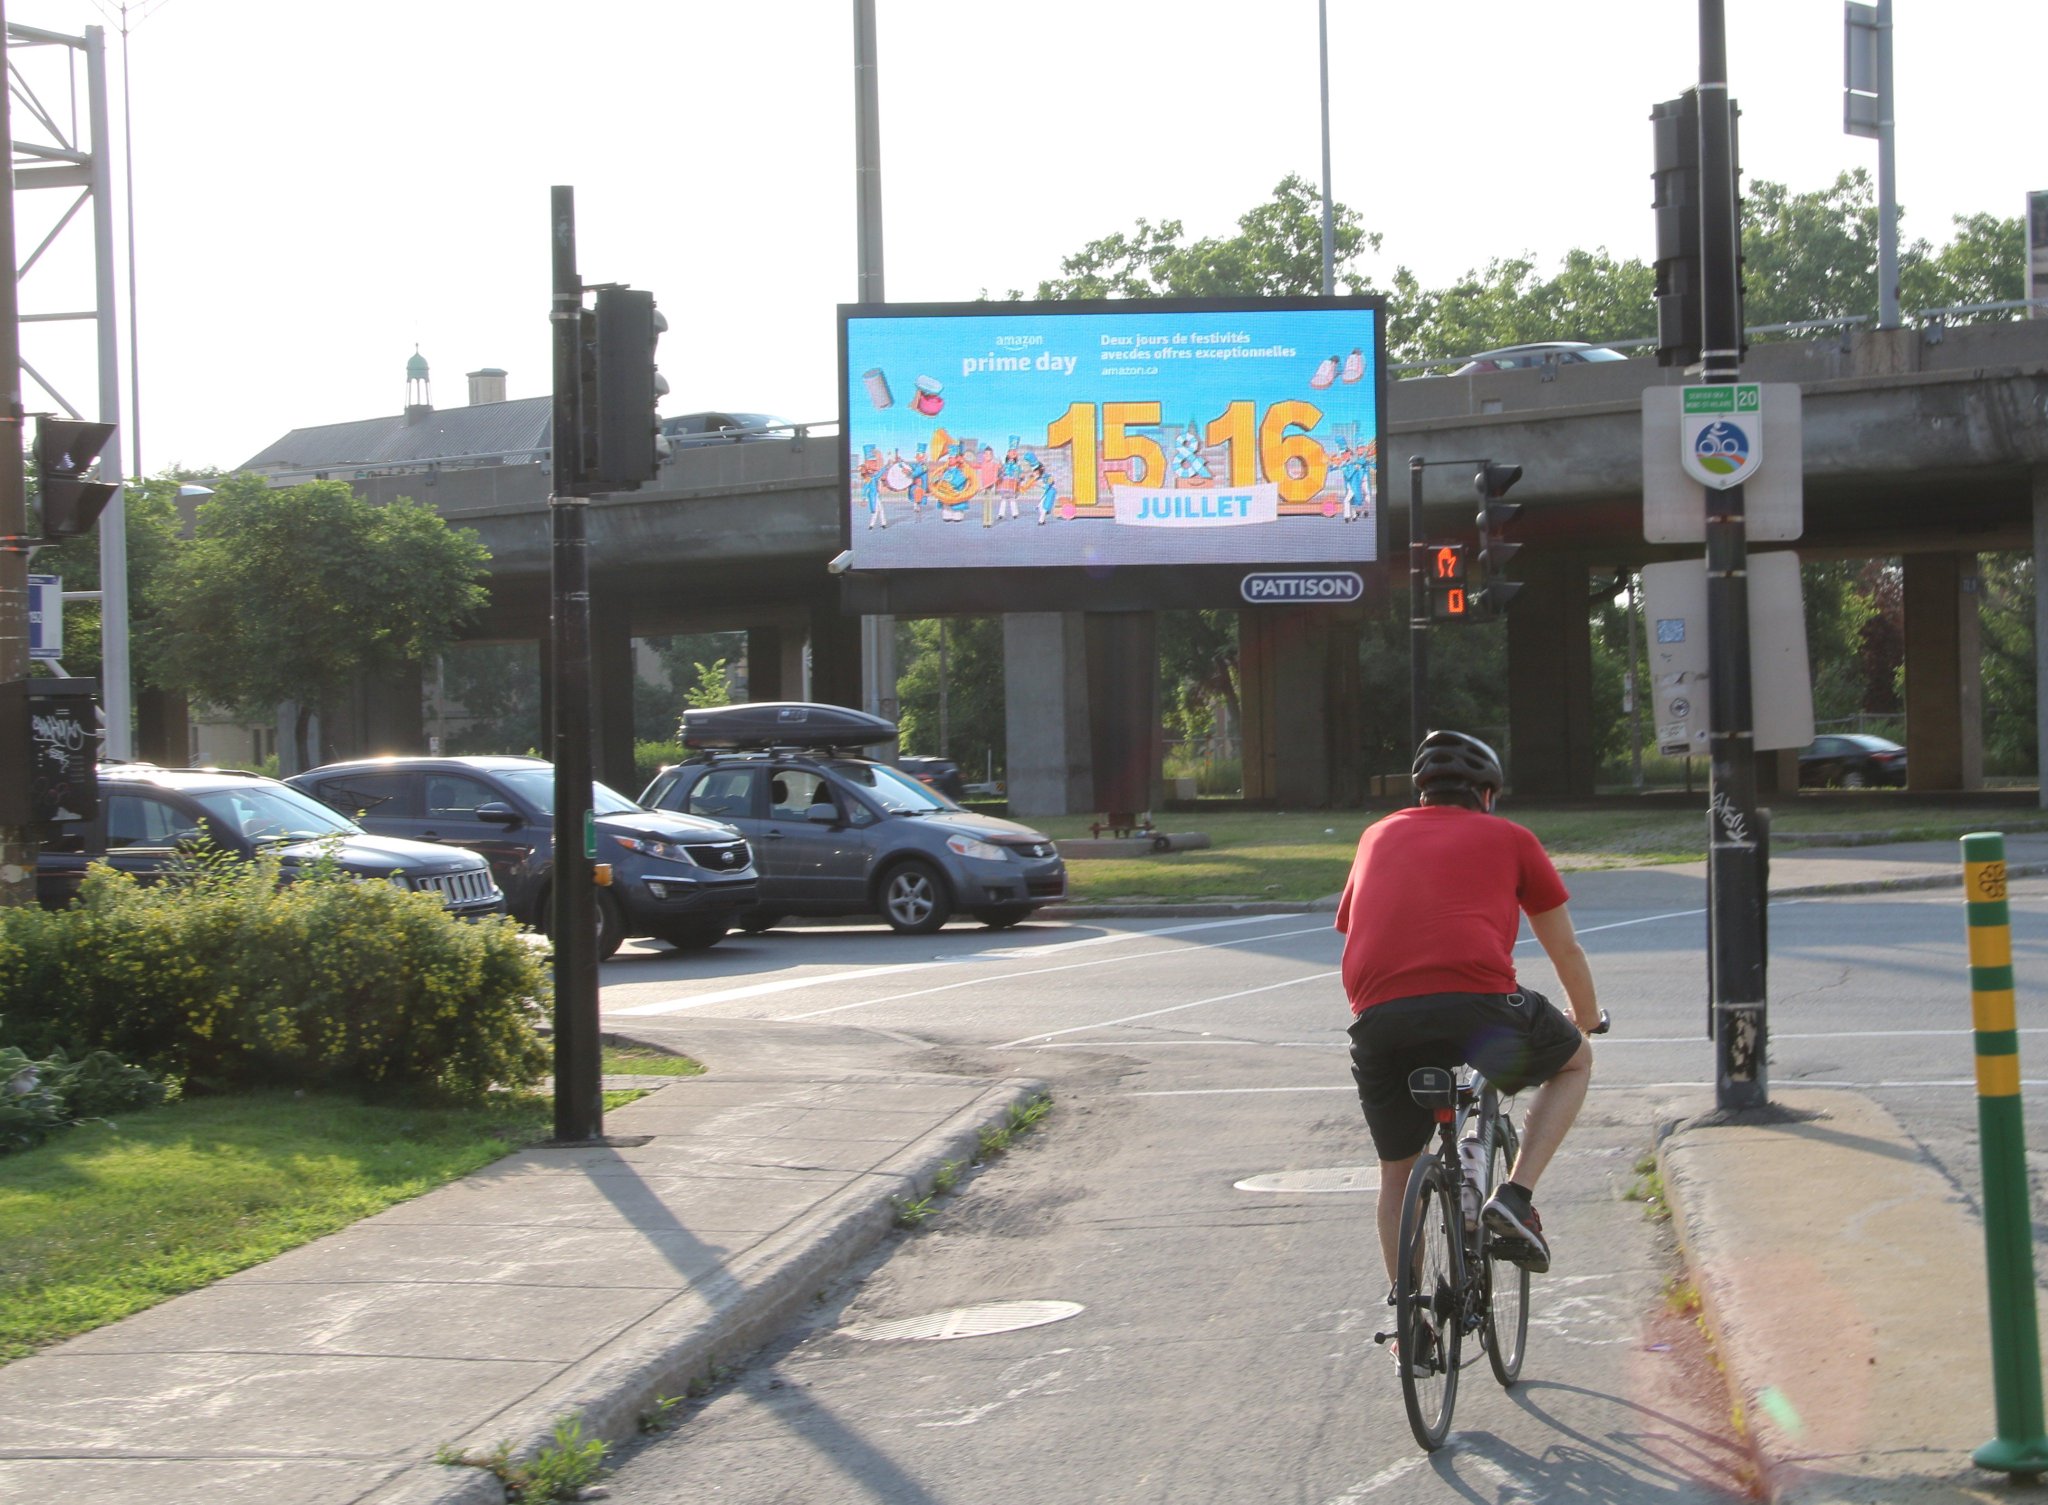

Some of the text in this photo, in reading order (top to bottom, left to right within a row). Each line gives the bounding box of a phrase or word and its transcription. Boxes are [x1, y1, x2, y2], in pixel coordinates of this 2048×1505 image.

[996, 334, 1044, 346] amazon
[1100, 331, 1251, 347] Deux jours de festivités
[1154, 347, 1192, 359] offres
[1195, 345, 1297, 360] exceptionnelles
[962, 351, 1078, 377] prime day
[1101, 365, 1159, 376] amazon.ca
[1738, 390, 1758, 407] 20
[1047, 401, 1168, 507] 15
[1206, 400, 1328, 504] 16
[1136, 494, 1253, 519] JUILLET
[1250, 579, 1354, 597] PATTISON
